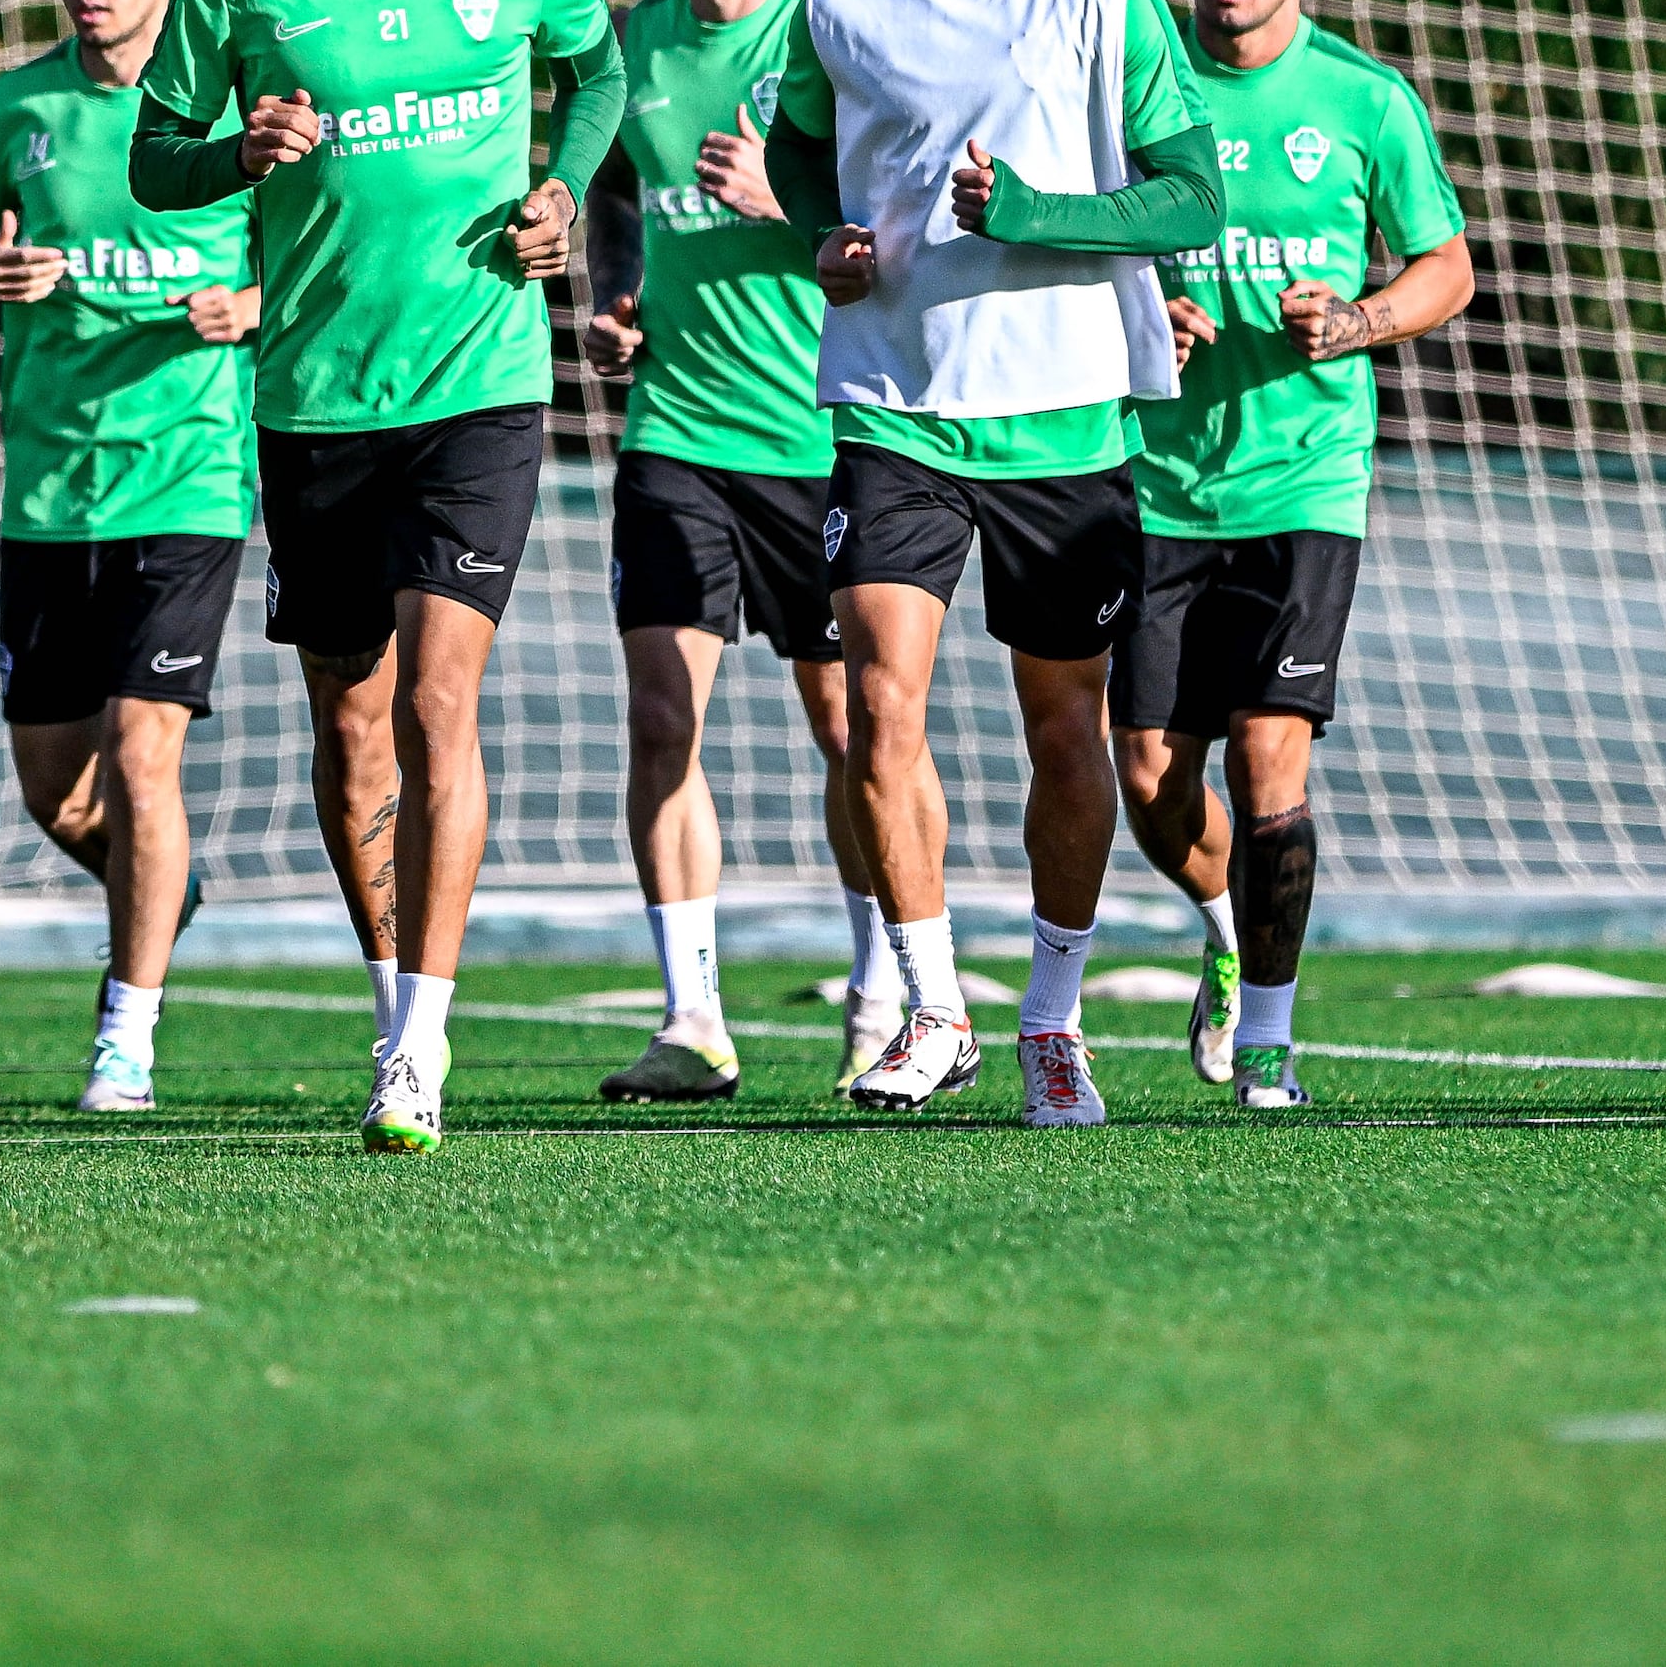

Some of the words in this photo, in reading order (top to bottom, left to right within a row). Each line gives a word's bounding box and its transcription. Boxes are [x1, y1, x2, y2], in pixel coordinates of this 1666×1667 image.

[378, 8, 409, 41] 21
[332, 145, 348, 158] EL
[352, 141, 378, 156] REY
[383, 137, 401, 152] DE
[405, 134, 423, 148] LA
[427, 128, 466, 145] FIBRA
[1217, 139, 1250, 171] 22
